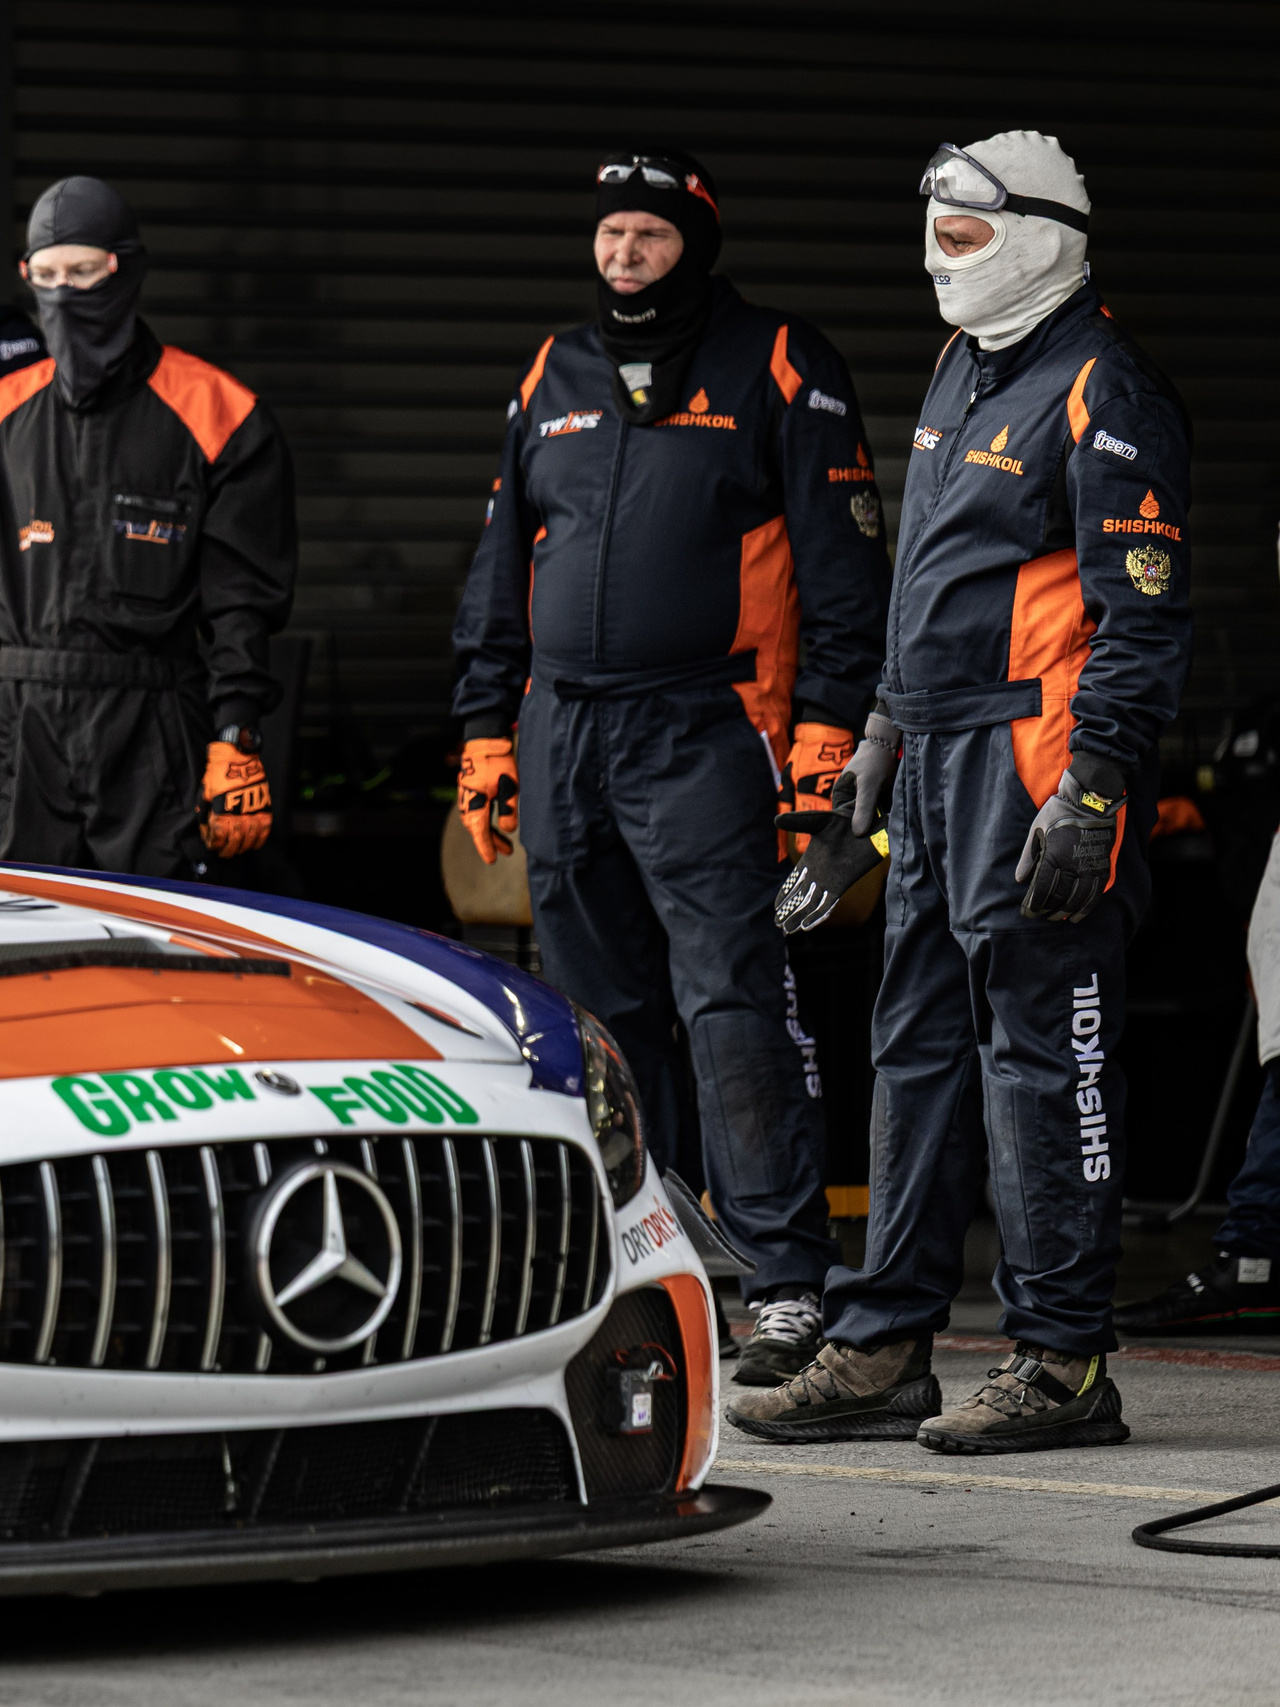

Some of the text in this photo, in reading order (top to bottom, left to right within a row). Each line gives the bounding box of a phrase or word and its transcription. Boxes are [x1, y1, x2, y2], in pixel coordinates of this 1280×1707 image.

[808, 388, 847, 416] freem
[1092, 430, 1138, 461] freem
[964, 450, 1024, 476] SHISHKOIL
[1102, 519, 1182, 541] SHISHKOIL
[224, 781, 271, 813] FOX
[1071, 972, 1111, 1182] SHISHKOIL
[51, 1063, 479, 1136] GROW FOOD
